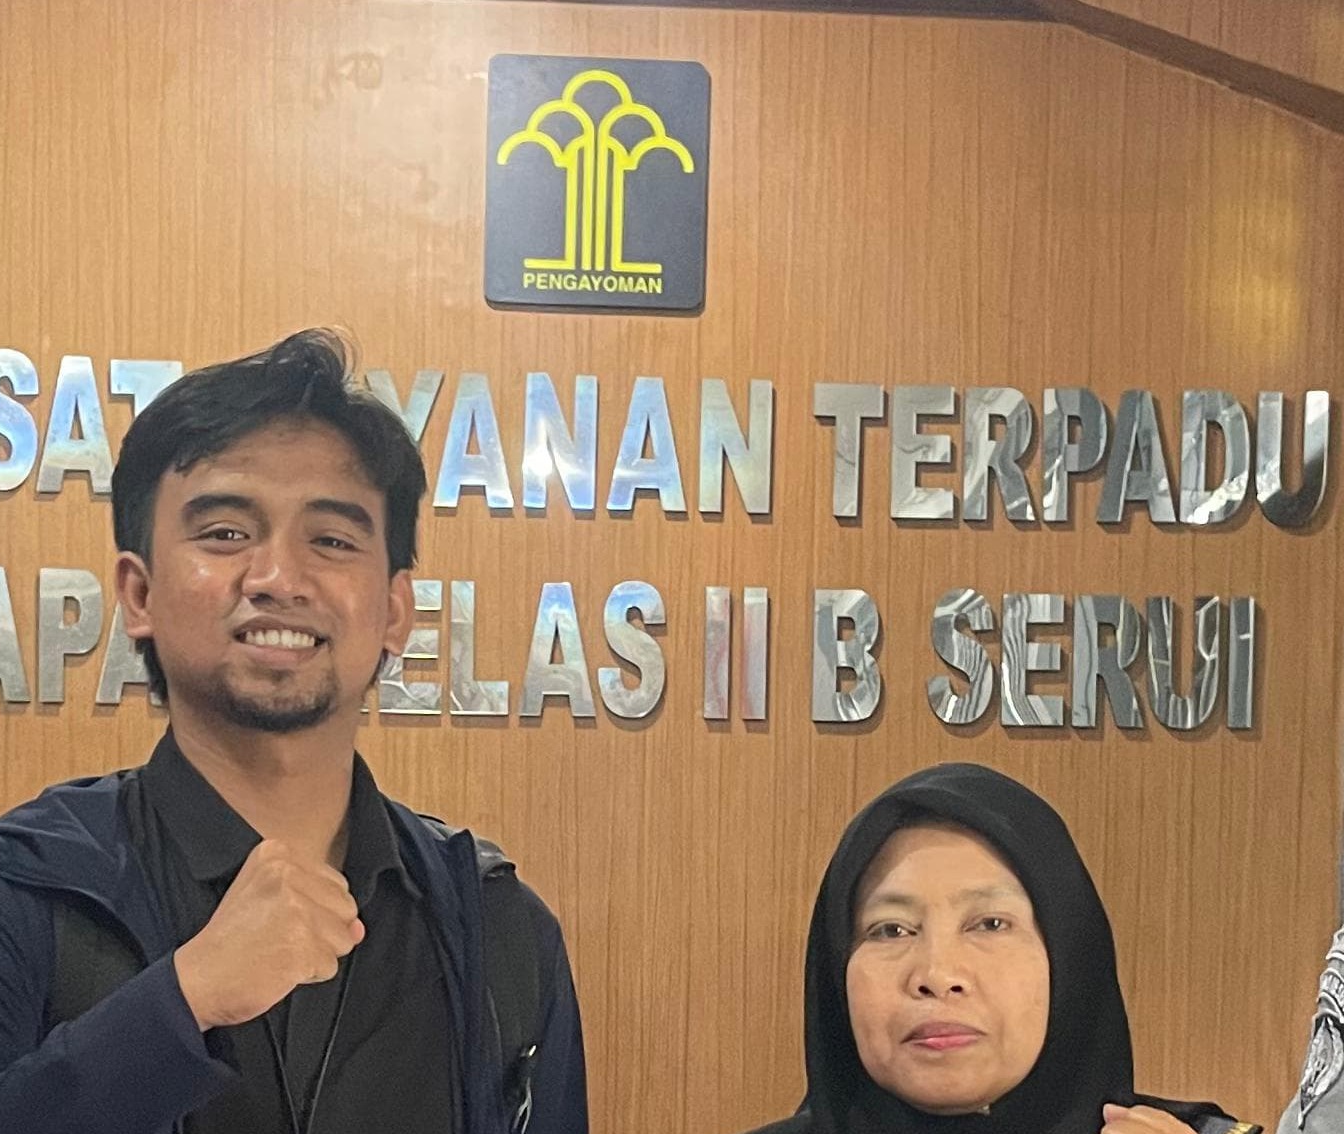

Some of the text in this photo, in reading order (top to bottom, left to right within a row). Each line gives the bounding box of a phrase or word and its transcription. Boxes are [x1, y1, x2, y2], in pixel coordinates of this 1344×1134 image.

[522, 272, 663, 295] PENGAYOMAN
[364, 369, 773, 514] YANAN
[814, 382, 1330, 526] TERPADU
[360, 579, 666, 719] ELAS
[704, 586, 768, 720] II
[812, 588, 880, 722] B
[926, 587, 1255, 730] SERUI
